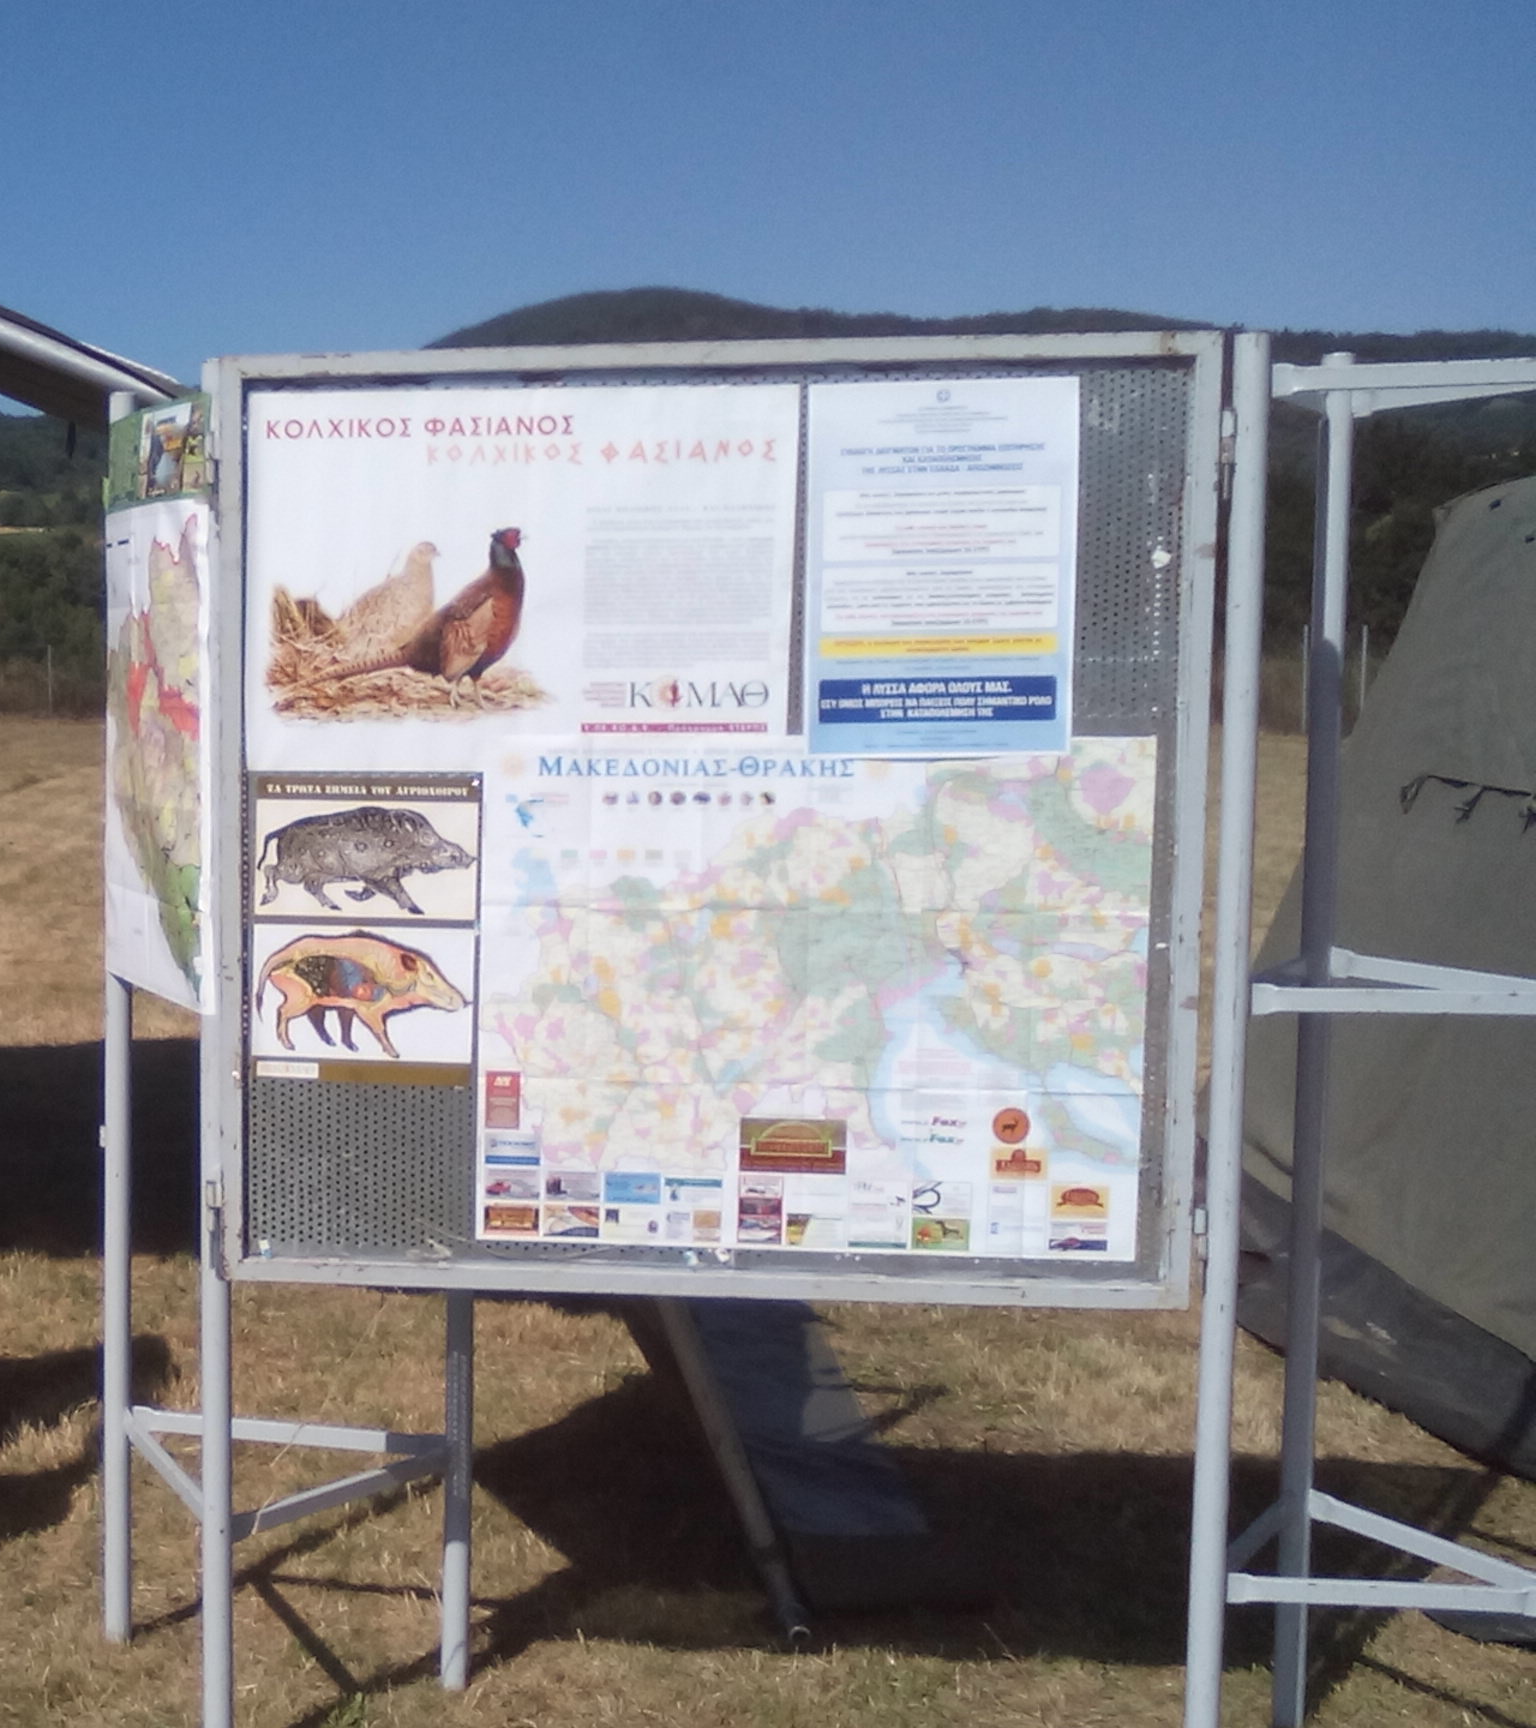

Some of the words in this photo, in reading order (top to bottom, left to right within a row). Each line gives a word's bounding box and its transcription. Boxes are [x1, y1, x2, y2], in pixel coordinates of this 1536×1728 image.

[265, 418, 413, 440] ΚΟΛΧΙΚΟΣ
[423, 415, 575, 437] ΦΑΣΙΑΝΟΣ
[425, 442, 583, 465] ΚΟΛΧΙΚΟΣ
[600, 439, 777, 464] ΦΑΣΙΑΝΟΣ
[266, 783, 282, 794] ΤΑ
